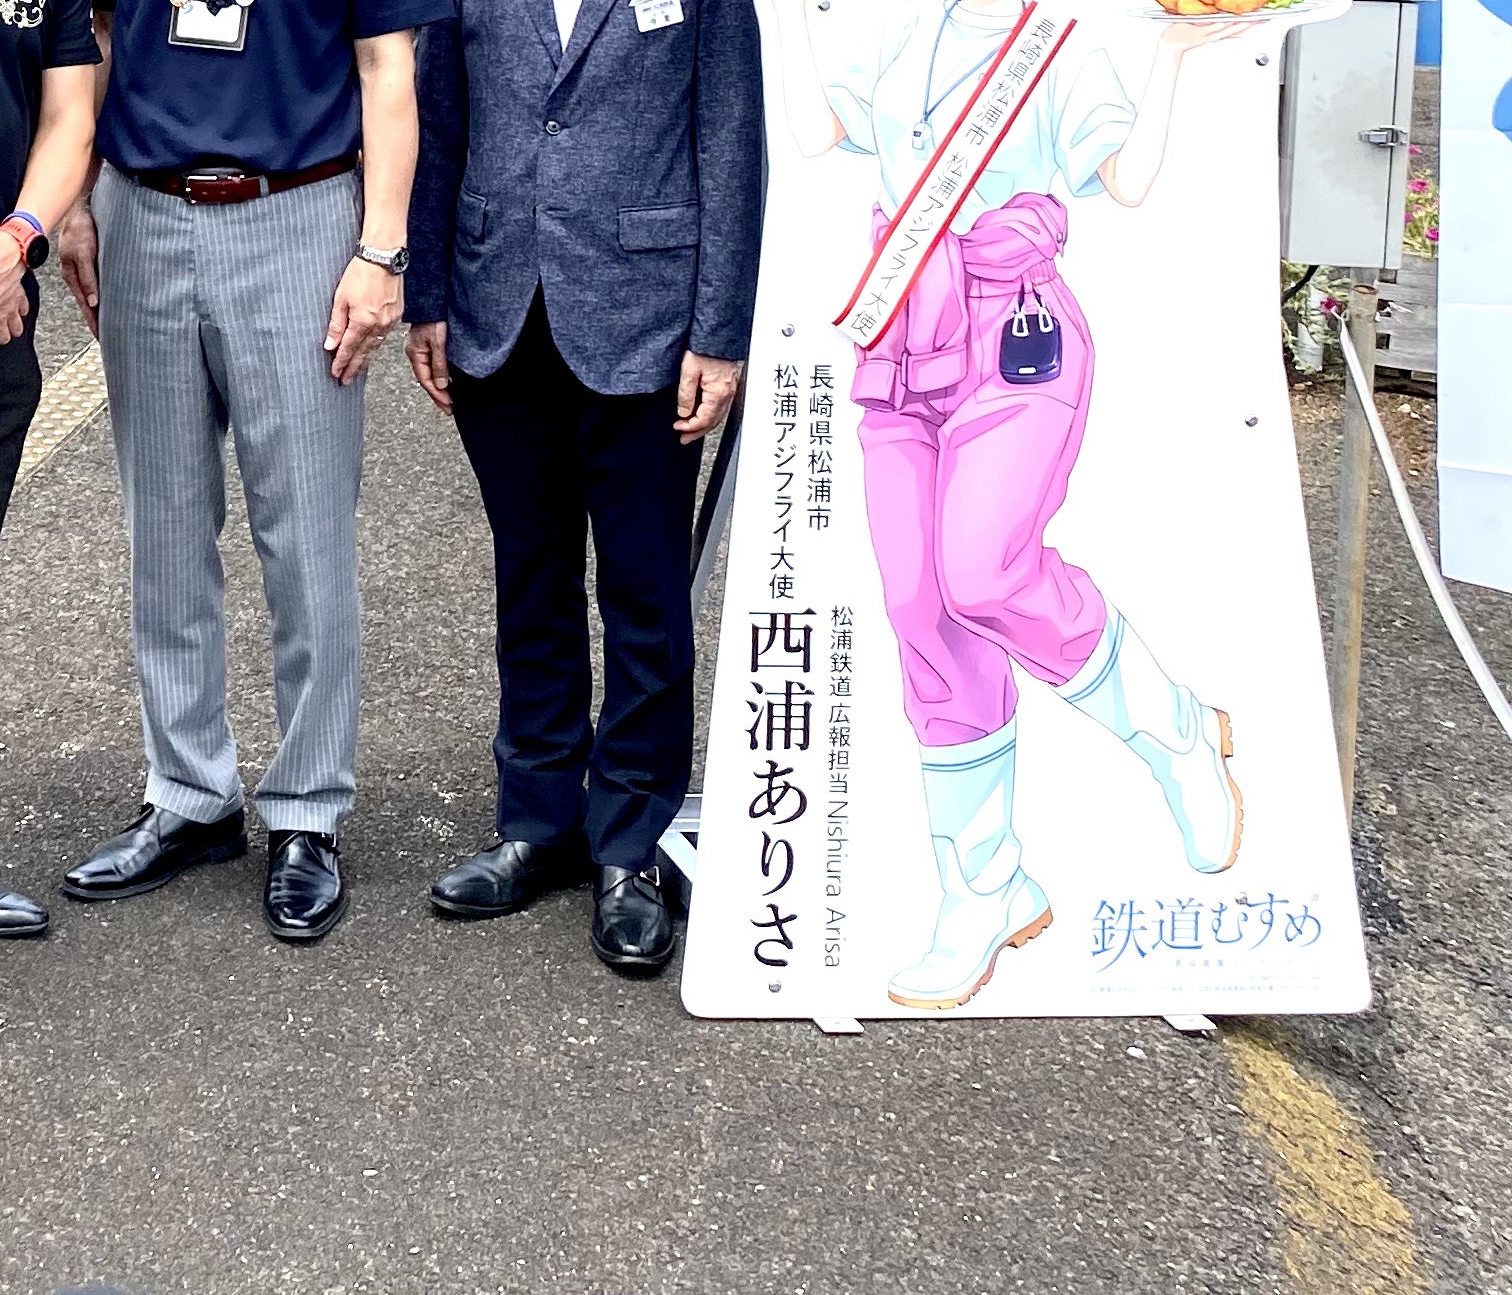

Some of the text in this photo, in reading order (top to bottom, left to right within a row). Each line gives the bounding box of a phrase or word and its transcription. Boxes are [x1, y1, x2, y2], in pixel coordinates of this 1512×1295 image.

[850, 17, 1057, 338] 長崎県松浦市 松浦アジフライ大使
[768, 363, 800, 601] 松浦アジフライ大使
[806, 363, 835, 531] 長崎県松浦市
[744, 607, 818, 968] 西浦ありさ
[825, 800, 850, 897] Nishiura
[824, 906, 848, 968] Arisa
[1090, 892, 1322, 974] 鉄道むすめ
